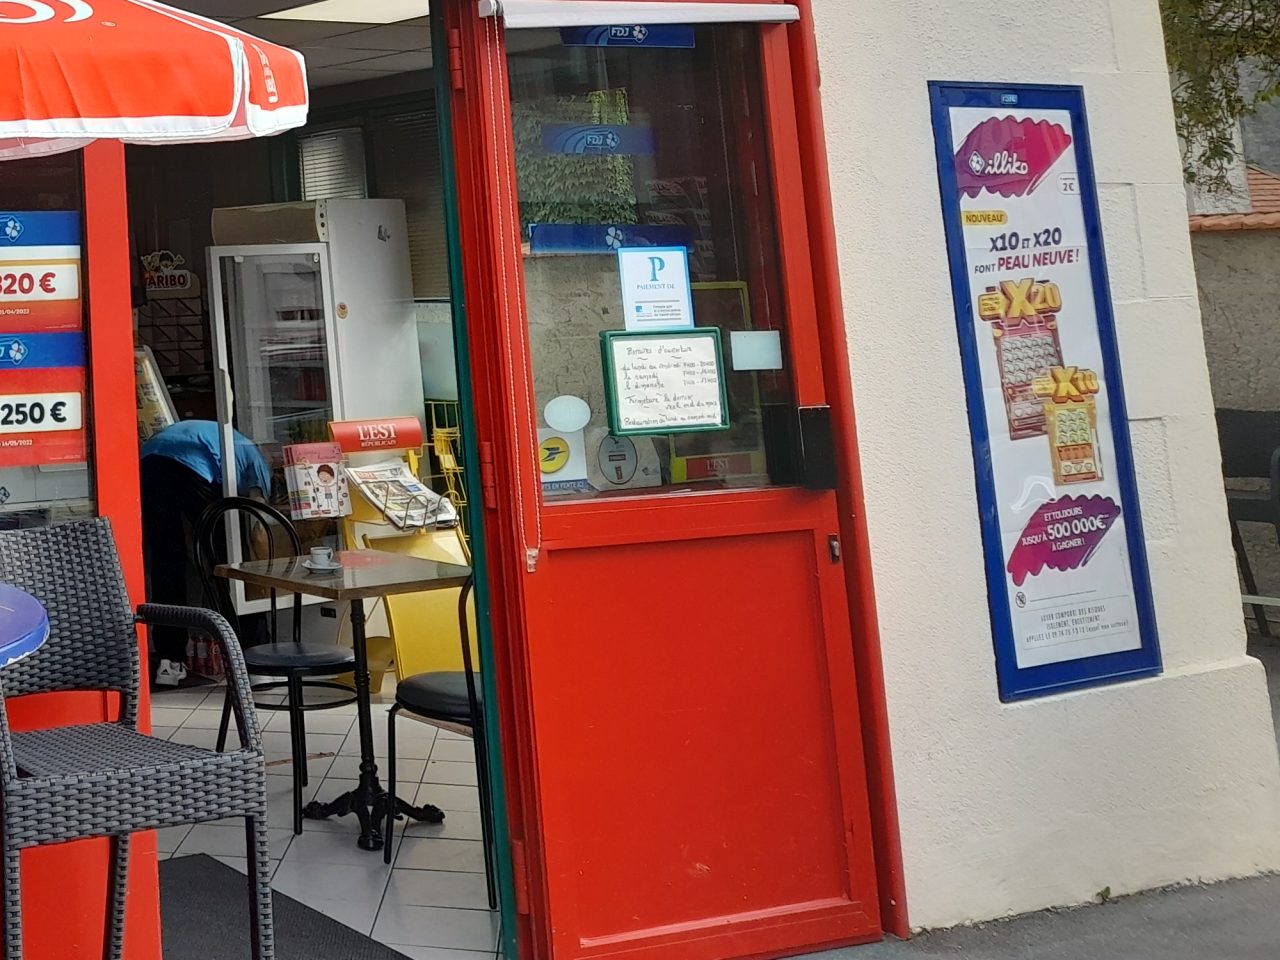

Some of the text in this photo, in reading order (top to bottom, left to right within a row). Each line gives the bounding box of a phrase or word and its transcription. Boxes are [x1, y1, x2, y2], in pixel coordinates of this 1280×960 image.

[611, 26, 629, 37] FDJ
[586, 135, 603, 145] FDJ
[984, 150, 1028, 175] illiko
[966, 214, 1003, 223] NOUVEAU
[1021, 238, 1031, 249] ET
[974, 264, 996, 274] FONT
[998, 255, 1030, 271] PEAU
[1032, 250, 1074, 267] NEUVE
[39, 272, 56, 293] €
[146, 274, 186, 288] ARIBO
[50, 401, 67, 423] €
[357, 423, 397, 441] L'EST
